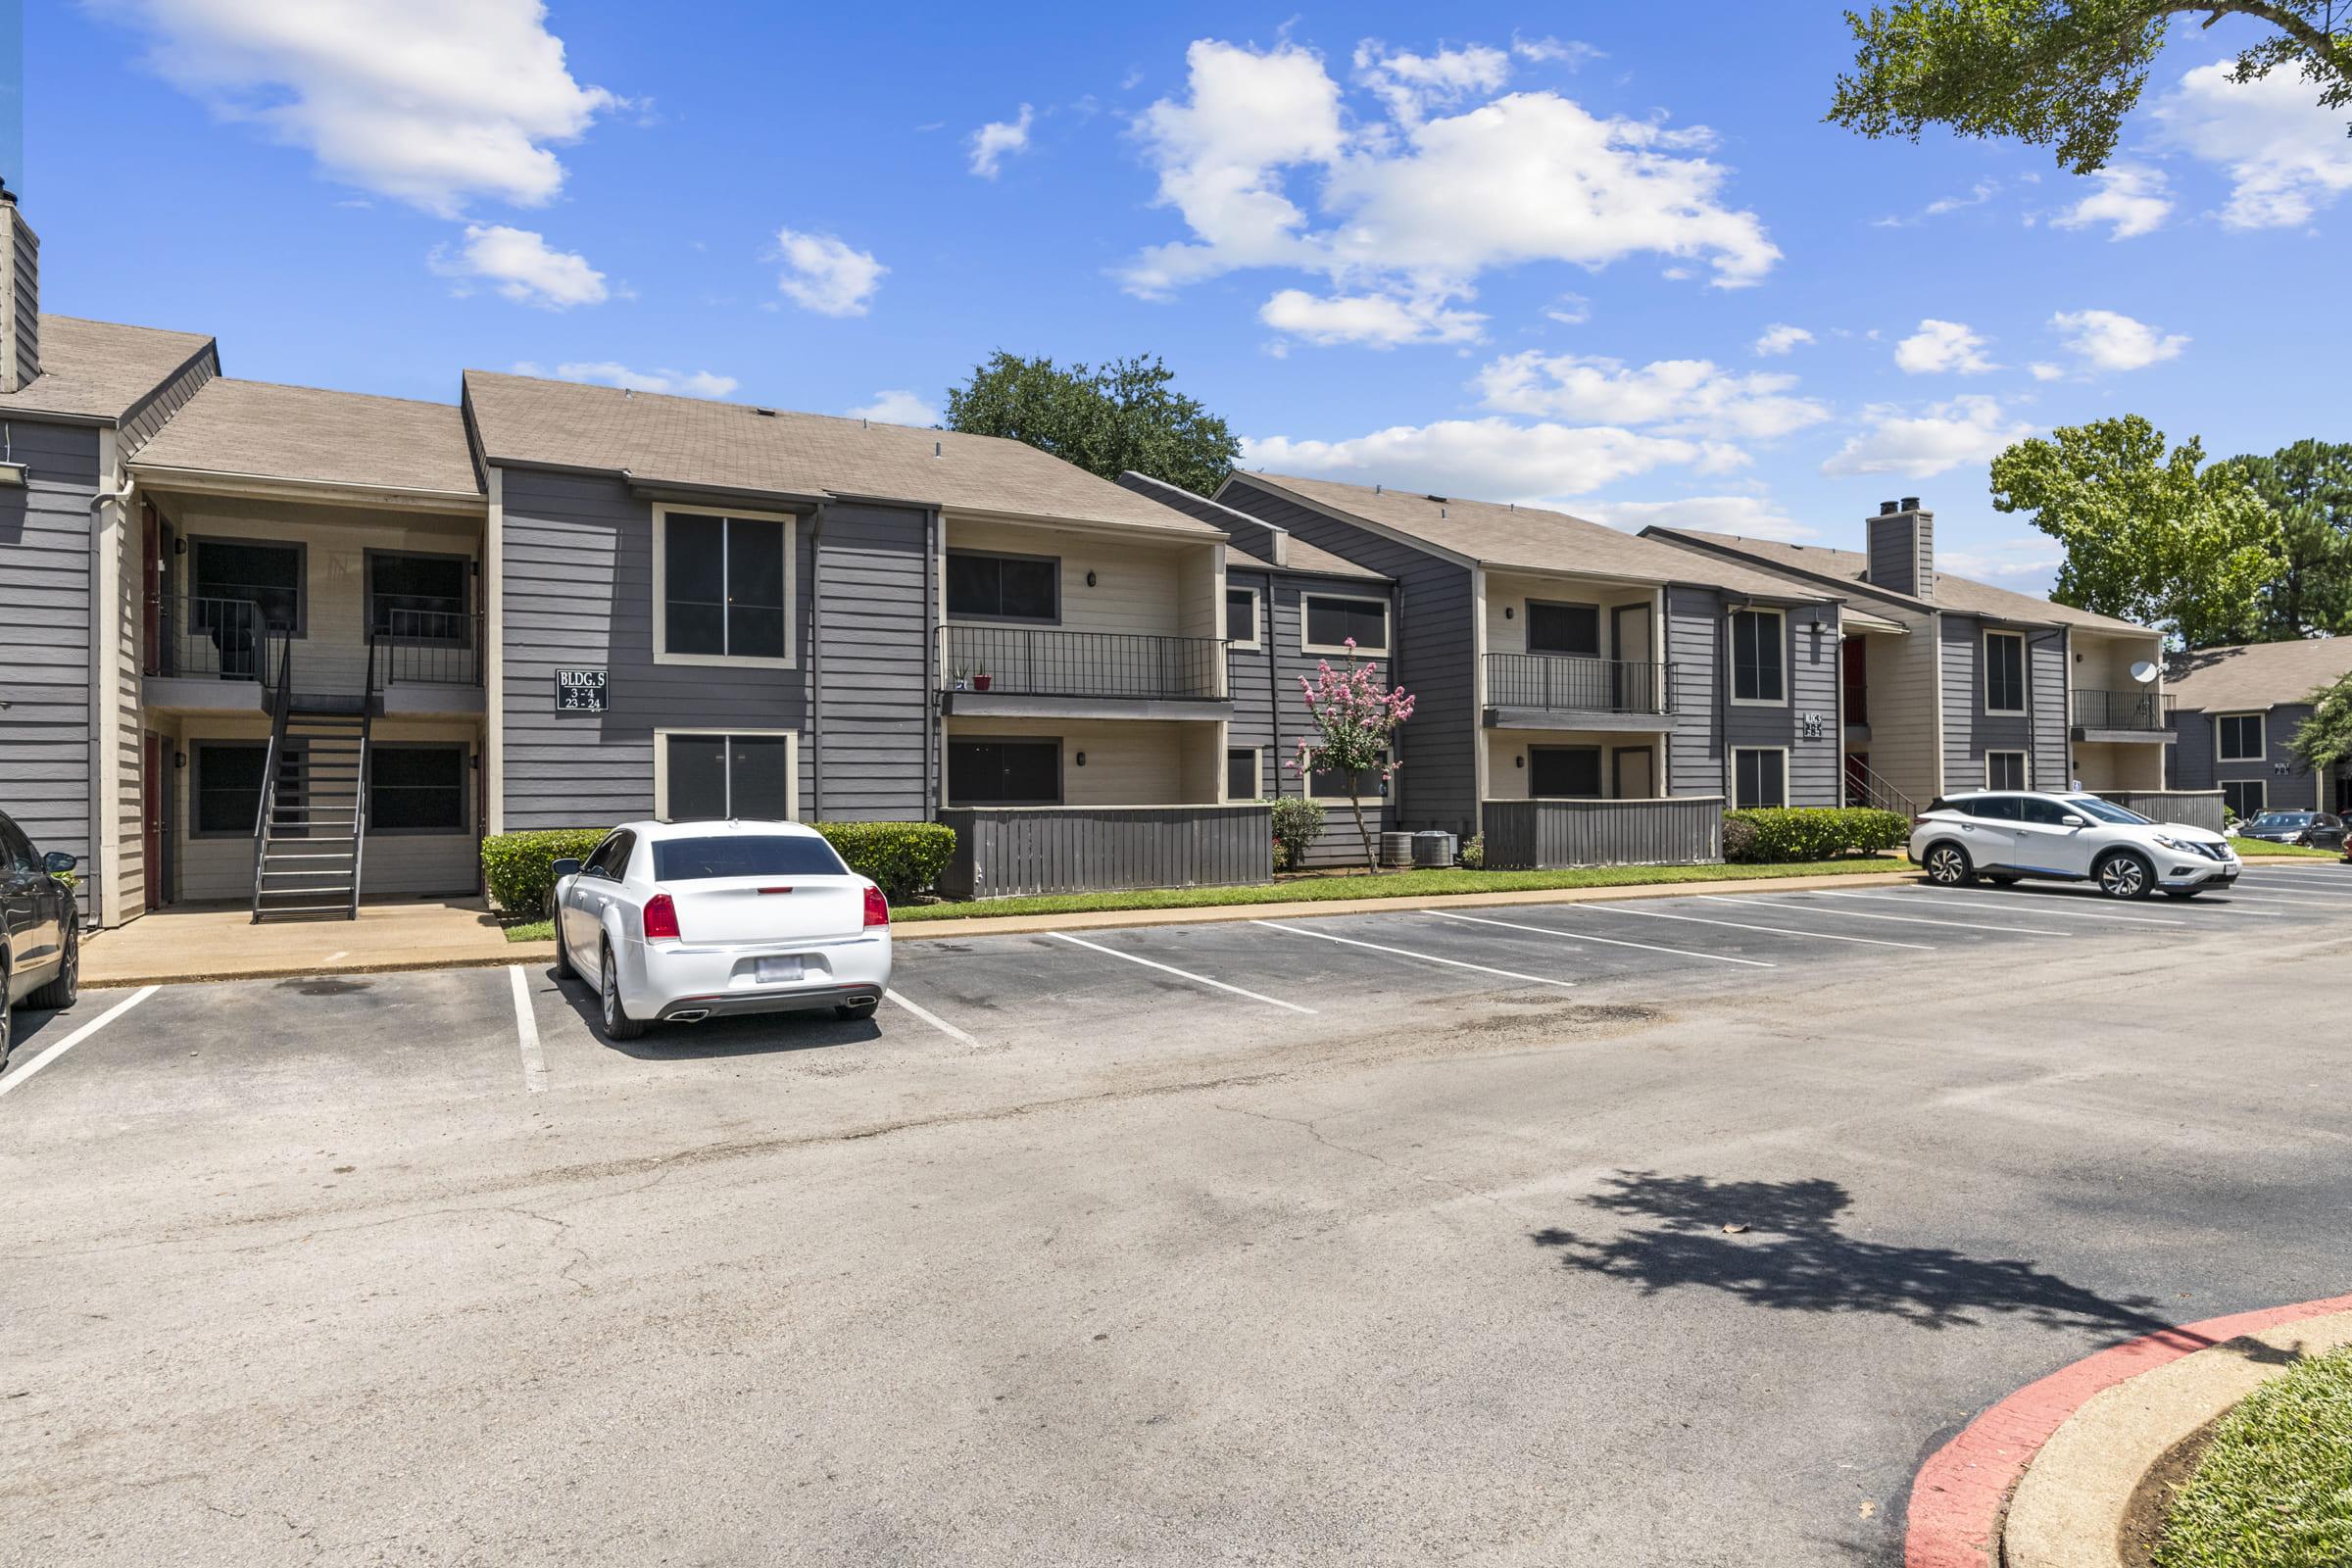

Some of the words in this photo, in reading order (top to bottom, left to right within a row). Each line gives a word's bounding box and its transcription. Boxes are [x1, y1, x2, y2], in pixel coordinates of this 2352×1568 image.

[561, 671, 596, 686] BLDG.
[598, 672, 605, 686] S
[571, 688, 578, 698] 3
[588, 688, 595, 698] 4
[565, 698, 578, 709] 23
[588, 698, 600, 709] 24
